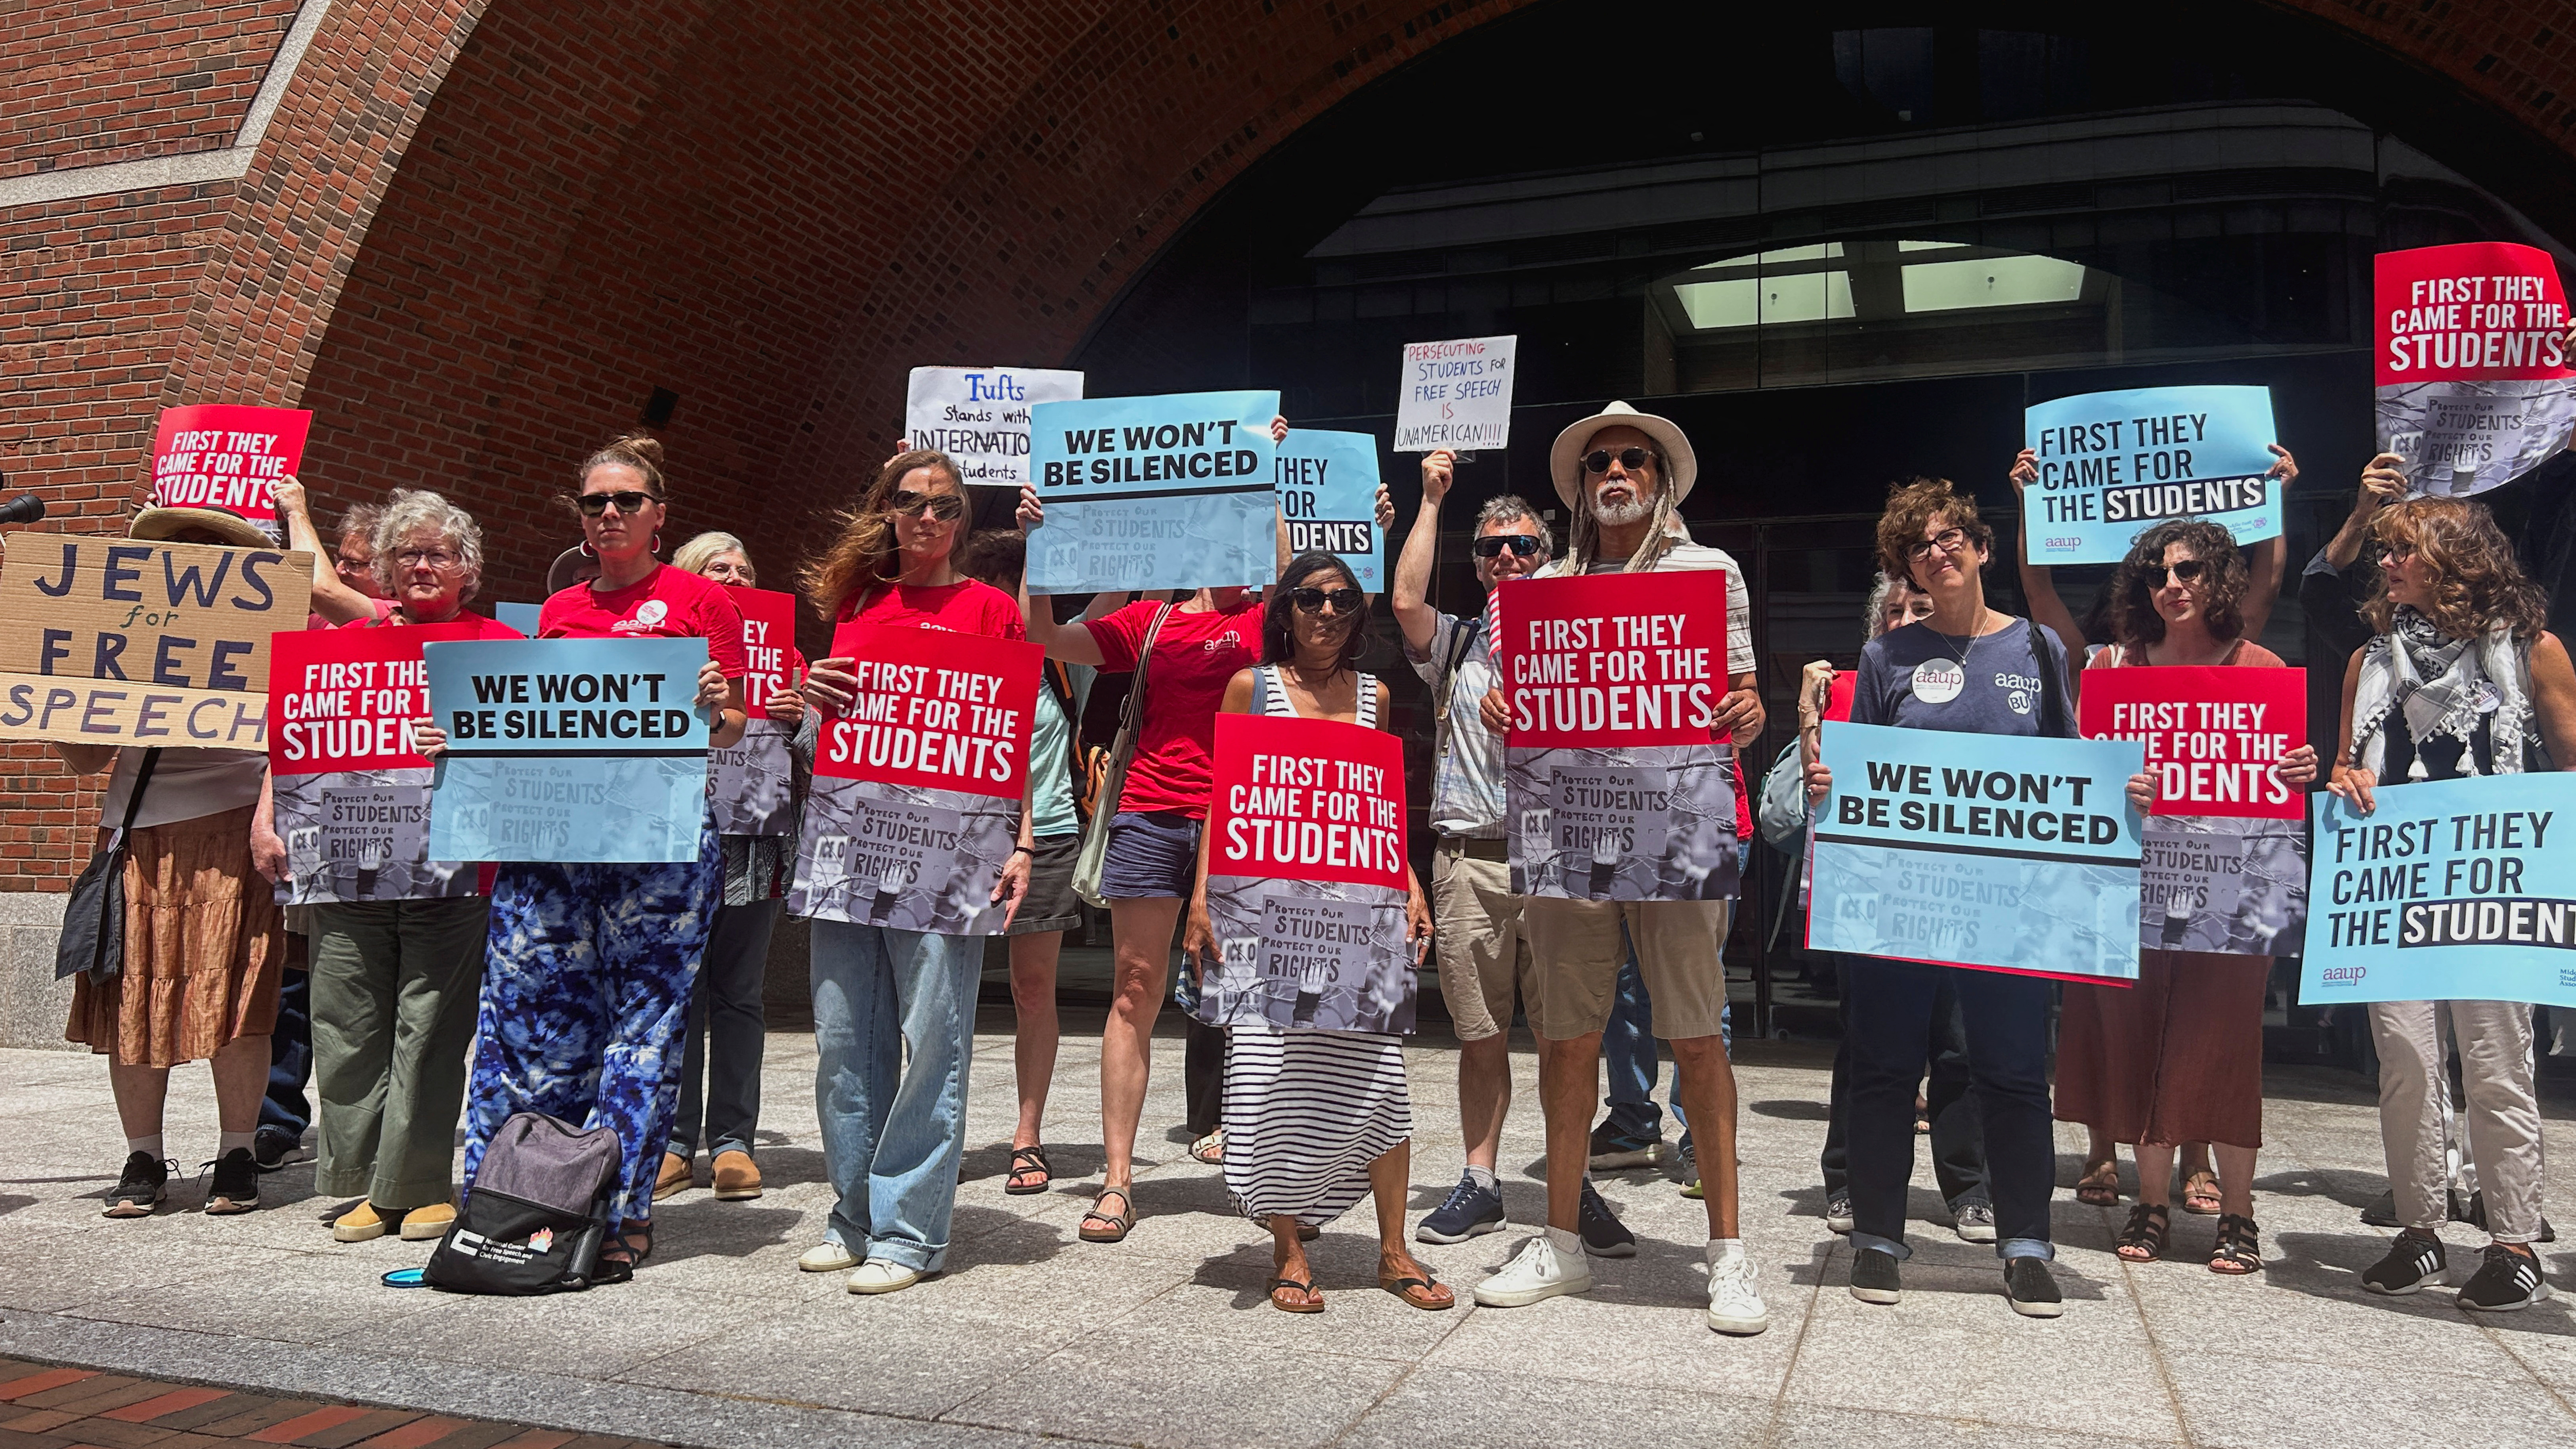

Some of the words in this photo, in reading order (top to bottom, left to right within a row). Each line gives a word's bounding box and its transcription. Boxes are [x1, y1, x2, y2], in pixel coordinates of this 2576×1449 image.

[2412, 277, 2486, 305] FIRST
[2492, 276, 2544, 301] THEY
[2391, 305, 2461, 334] CAME
[2471, 304, 2515, 329] FOR
[2524, 304, 2565, 328] THE
[1409, 343, 1485, 362] PERSECUTING
[2389, 331, 2564, 371] STUDENTS
[1419, 360, 1483, 381] STUDENTS
[1490, 358, 1506, 372] FOR
[965, 374, 1025, 401] Tufts
[1415, 384, 1448, 402] FREE
[1455, 379, 1501, 400] SPEECH
[943, 405, 992, 422] Stands
[1003, 408, 1031, 424] with
[1443, 402, 1454, 419] IS
[2429, 400, 2470, 411] PROTECT
[1398, 423, 1501, 447] UNAMERICAN!!!!
[2041, 421, 2122, 457] FIRST
[2132, 413, 2207, 447] THEY
[2426, 430, 2465, 440] PROTECT
[2437, 413, 2522, 430] STUDENTS
[171, 431, 223, 452] FIRST
[227, 432, 278, 454] THEY
[912, 428, 1030, 456] INTERNATIO
[1065, 428, 1115, 455] WE
[1123, 420, 1238, 450] WON'T
[157, 452, 200, 476] CAME
[202, 452, 243, 474] FOR
[250, 455, 287, 477] THE
[958, 459, 1017, 480] tudents
[1044, 461, 1084, 487] BE
[1090, 450, 1257, 484] SILENCED
[1275, 457, 1328, 485] THEY
[2042, 456, 2123, 491] CAME
[2134, 449, 2193, 482] FOR
[155, 474, 281, 509] STUDENTS
[2042, 493, 2096, 523] THE
[2107, 478, 2262, 519] STUDENTS
[1082, 504, 1129, 518] PROTECT
[1134, 504, 1157, 515] OUR
[1092, 519, 1185, 539] STUDENTS
[1285, 523, 1369, 551] DENTS
[2045, 537, 2081, 551] aaup
[33, 543, 285, 611] JEWS
[119, 605, 180, 628] for
[744, 620, 769, 644] EY
[1530, 617, 1603, 650] FIRST
[1612, 614, 1686, 648] THEY
[41, 628, 254, 691] FREE
[746, 646, 783, 672] THE
[1514, 653, 1578, 685] CAME
[1590, 650, 1646, 683] FOR
[1656, 648, 1710, 680] THE
[305, 662, 377, 690] FIRST
[384, 660, 429, 687] THE
[472, 674, 529, 703] WE
[537, 673, 665, 702] WON'T
[857, 661, 930, 695] FIRST
[936, 669, 1003, 705] THEY
[1916, 671, 1962, 690] aaup
[1995, 673, 2041, 700] aaup
[1, 684, 269, 743] SPEECH
[284, 690, 352, 720] CAME
[361, 688, 410, 716] FOR
[1514, 683, 1712, 732] STUDENTS
[2010, 696, 2029, 710] BU
[2114, 702, 2188, 730] FIRST
[2197, 703, 2266, 730] THEY
[453, 711, 495, 739] BE
[504, 709, 689, 739] SILENCED
[907, 697, 959, 730] FOR
[971, 705, 1019, 739] THE
[283, 717, 419, 761] STUDEN
[830, 721, 1015, 782] STUDENTS
[2173, 732, 2226, 759] FOR
[2236, 733, 2288, 760] THE
[495, 761, 543, 778] PROTECT
[549, 765, 572, 778] OUR
[1253, 754, 1327, 787] FIRST
[1335, 761, 1384, 795] THEY
[1553, 770, 1602, 786] PROTECT
[1609, 776, 1634, 786] OUR
[505, 778, 604, 805] STUDENTS
[1867, 761, 1932, 795] WE
[1942, 768, 2091, 806] WON'T
[2150, 762, 2288, 805] DENTS
[323, 793, 367, 804] PROTECT
[373, 793, 395, 803] OUR
[856, 800, 900, 820] PROTECT
[907, 812, 930, 823] OUR
[1230, 785, 1301, 818] CAME
[1312, 791, 1359, 822] FOR
[1367, 797, 1398, 830] THE
[1563, 787, 1667, 811] STUDENTS
[333, 805, 422, 823] STUDENTS
[1553, 808, 1603, 822] PROTECT
[1608, 813, 1634, 824] OUR
[1839, 795, 1890, 828] BE
[1899, 801, 2118, 845] SILENCED
[322, 825, 367, 835] PROTECT
[372, 826, 394, 835] OUR
[863, 817, 957, 851] STUDENTS
[2336, 819, 2438, 863] FIRST
[2450, 811, 2553, 852] THEY
[850, 836, 894, 854] PROTECT
[900, 846, 923, 858] OUR
[1225, 817, 1400, 874] STUDENTS
[2186, 840, 2210, 849] OUR
[1886, 852, 1947, 873] PROTECT
[1955, 864, 1984, 876] OUR
[2141, 849, 2241, 874] STUDENTS
[1898, 871, 2020, 908] STUDENTS
[2184, 874, 2209, 883] OUR
[2332, 862, 2429, 905] CAME
[2444, 857, 2523, 895] FOR
[1265, 899, 1315, 917] PROTECT
[1321, 907, 1344, 918] OUR
[1882, 894, 1945, 913] PROTECT
[1951, 905, 1980, 917] OUR
[1275, 917, 1370, 945] STUDENTS
[2328, 908, 2391, 948] THE
[2404, 902, 2576, 944] STUDEN
[1261, 937, 1313, 952] PROTECT
[1318, 944, 1341, 956] OUR
[2323, 967, 2366, 986] aaup
